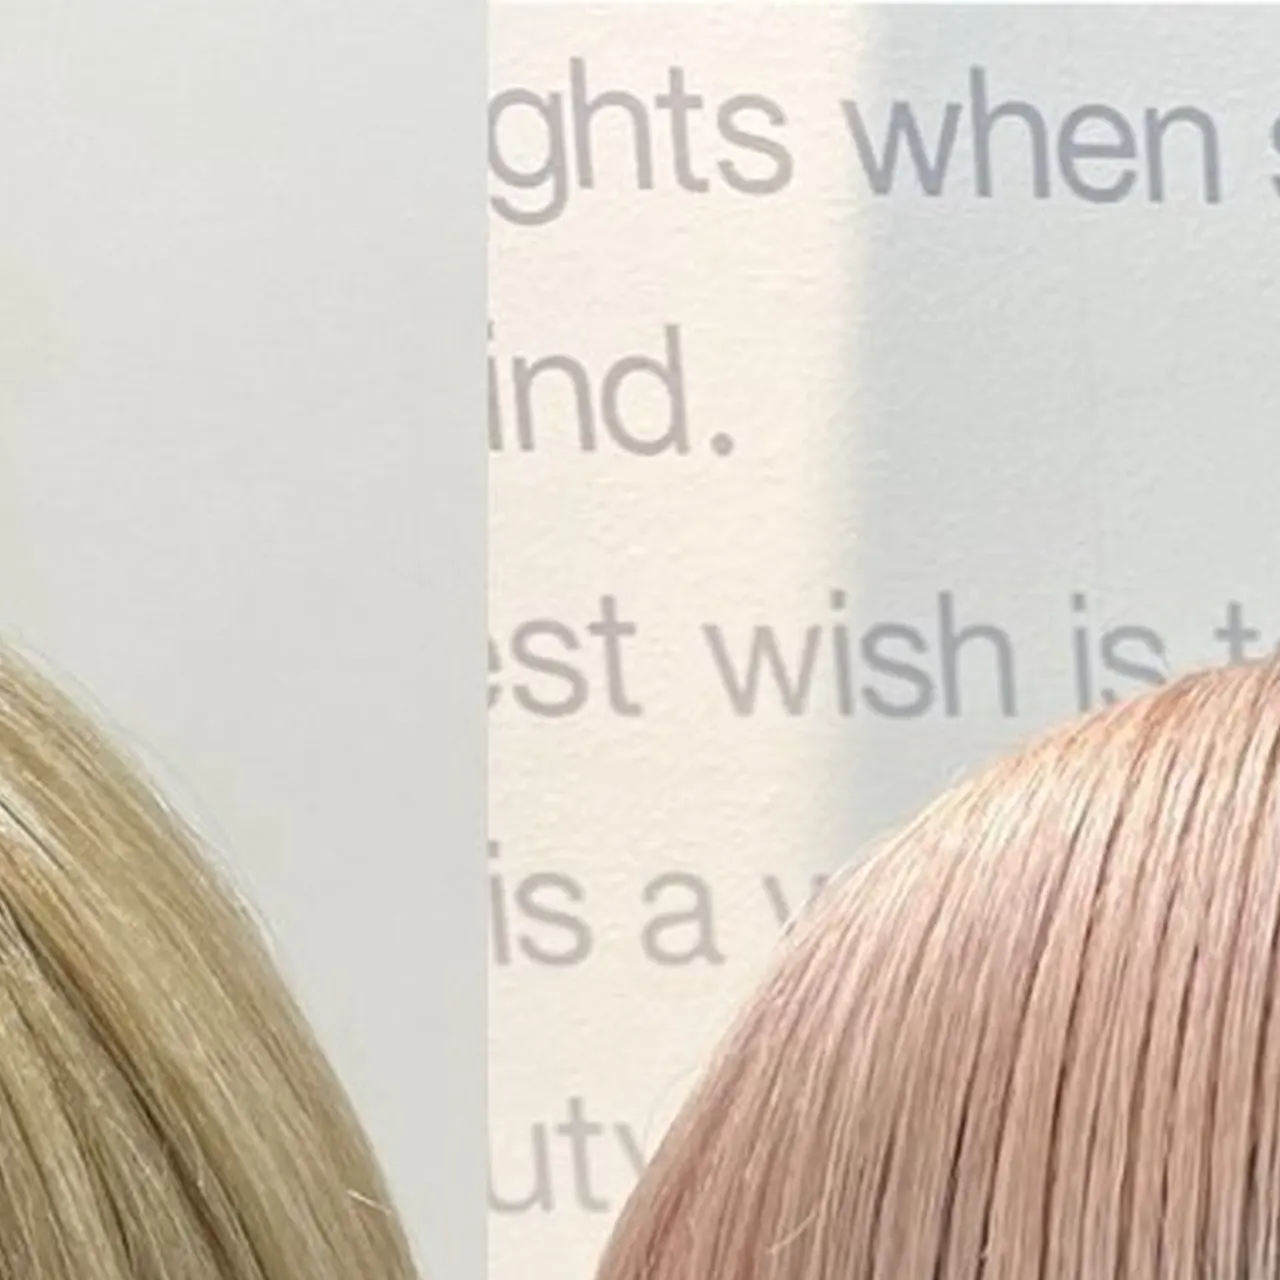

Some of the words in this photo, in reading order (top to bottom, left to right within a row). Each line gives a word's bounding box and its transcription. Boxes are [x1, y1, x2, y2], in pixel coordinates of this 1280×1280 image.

[841, 65, 1222, 204] when
[702, 590, 1018, 720] wish
[1072, 592, 1168, 714] is
[488, 840, 594, 967] is
[640, 869, 726, 967] a
